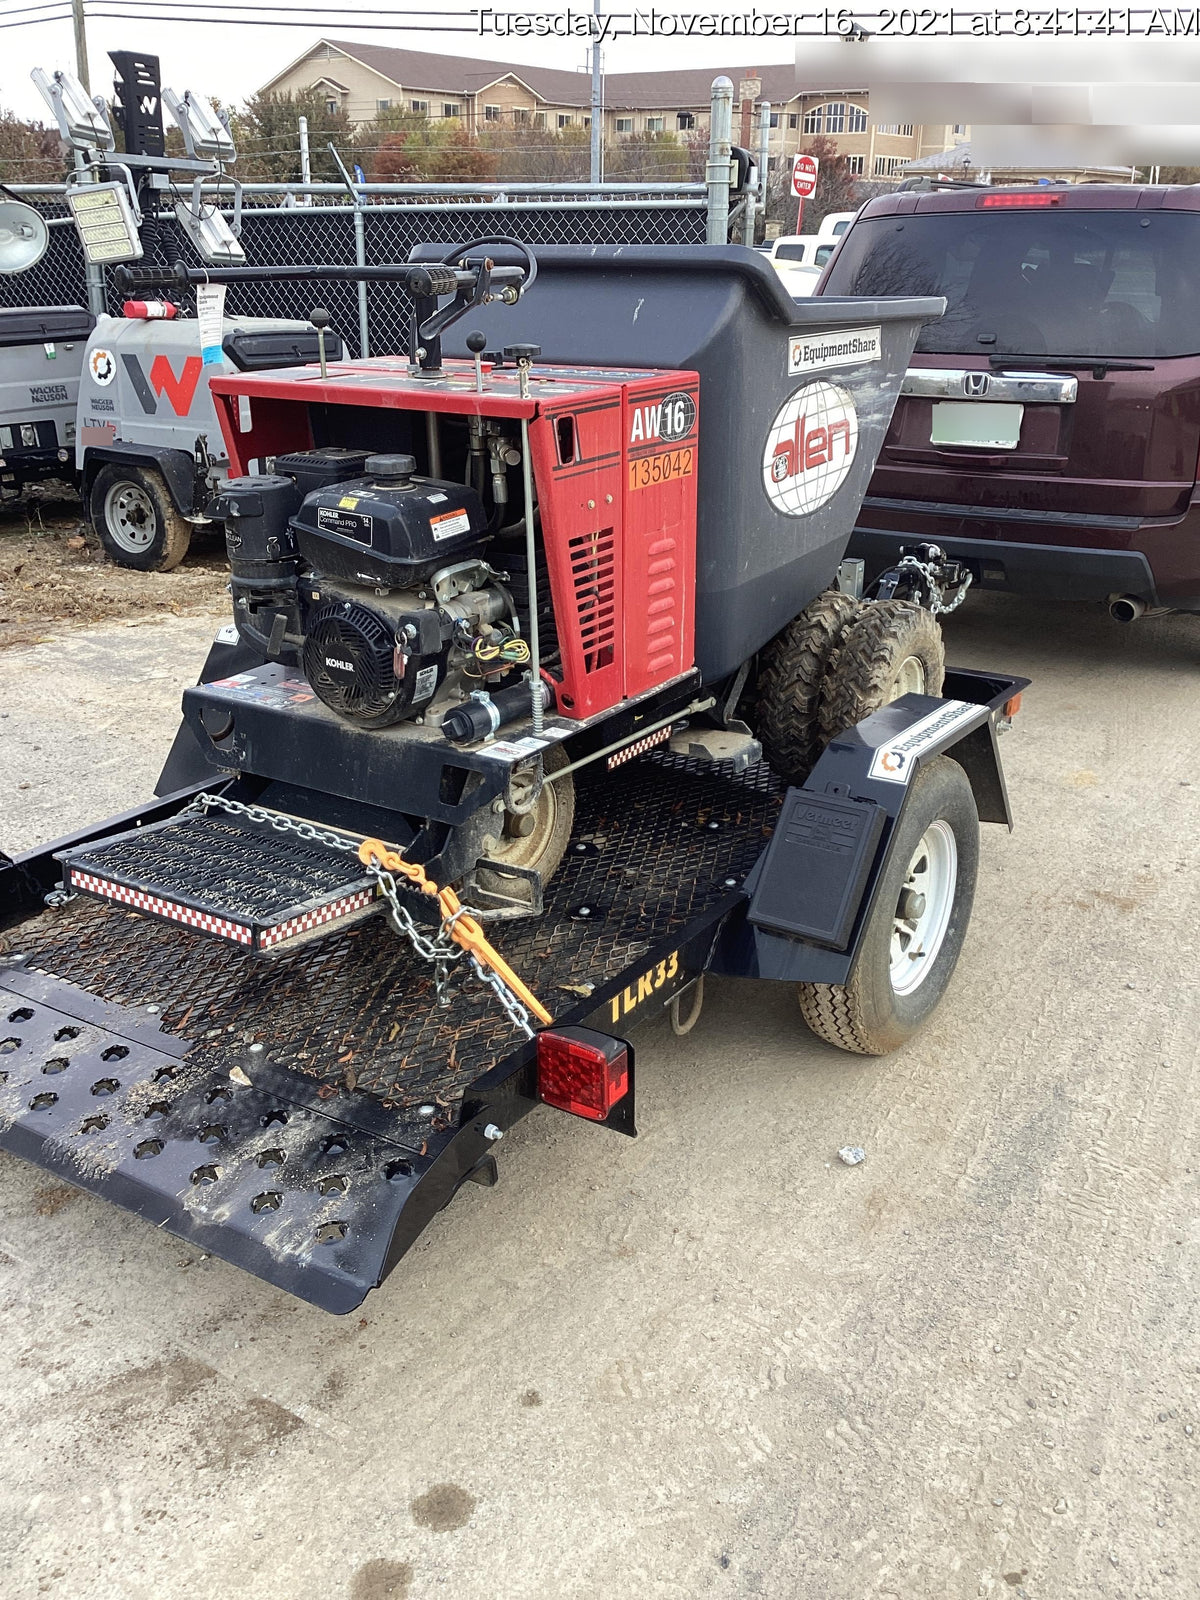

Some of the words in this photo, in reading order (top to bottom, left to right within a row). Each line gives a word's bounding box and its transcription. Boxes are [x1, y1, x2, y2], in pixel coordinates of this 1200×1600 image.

[797, 162, 805, 170] DO
[805, 163, 815, 173] NOT
[796, 180, 812, 191] ENTER
[803, 337, 876, 364] EquipmentShare
[29, 385, 66, 396] WACKER
[31, 392, 69, 403] NEUSON
[90, 397, 113, 405] WACKER
[91, 404, 115, 412] NEUSON
[771, 412, 850, 483] allen
[631, 449, 692, 488] 135042
[319, 510, 339, 519] KOHLER
[320, 516, 345, 526] Command
[345, 519, 357, 528] PRO
[325, 657, 356, 673] KOHLER
[892, 702, 976, 752] EquipmentShare
[795, 803, 858, 832] Vermeer
[608, 950, 679, 1024] TLK33
